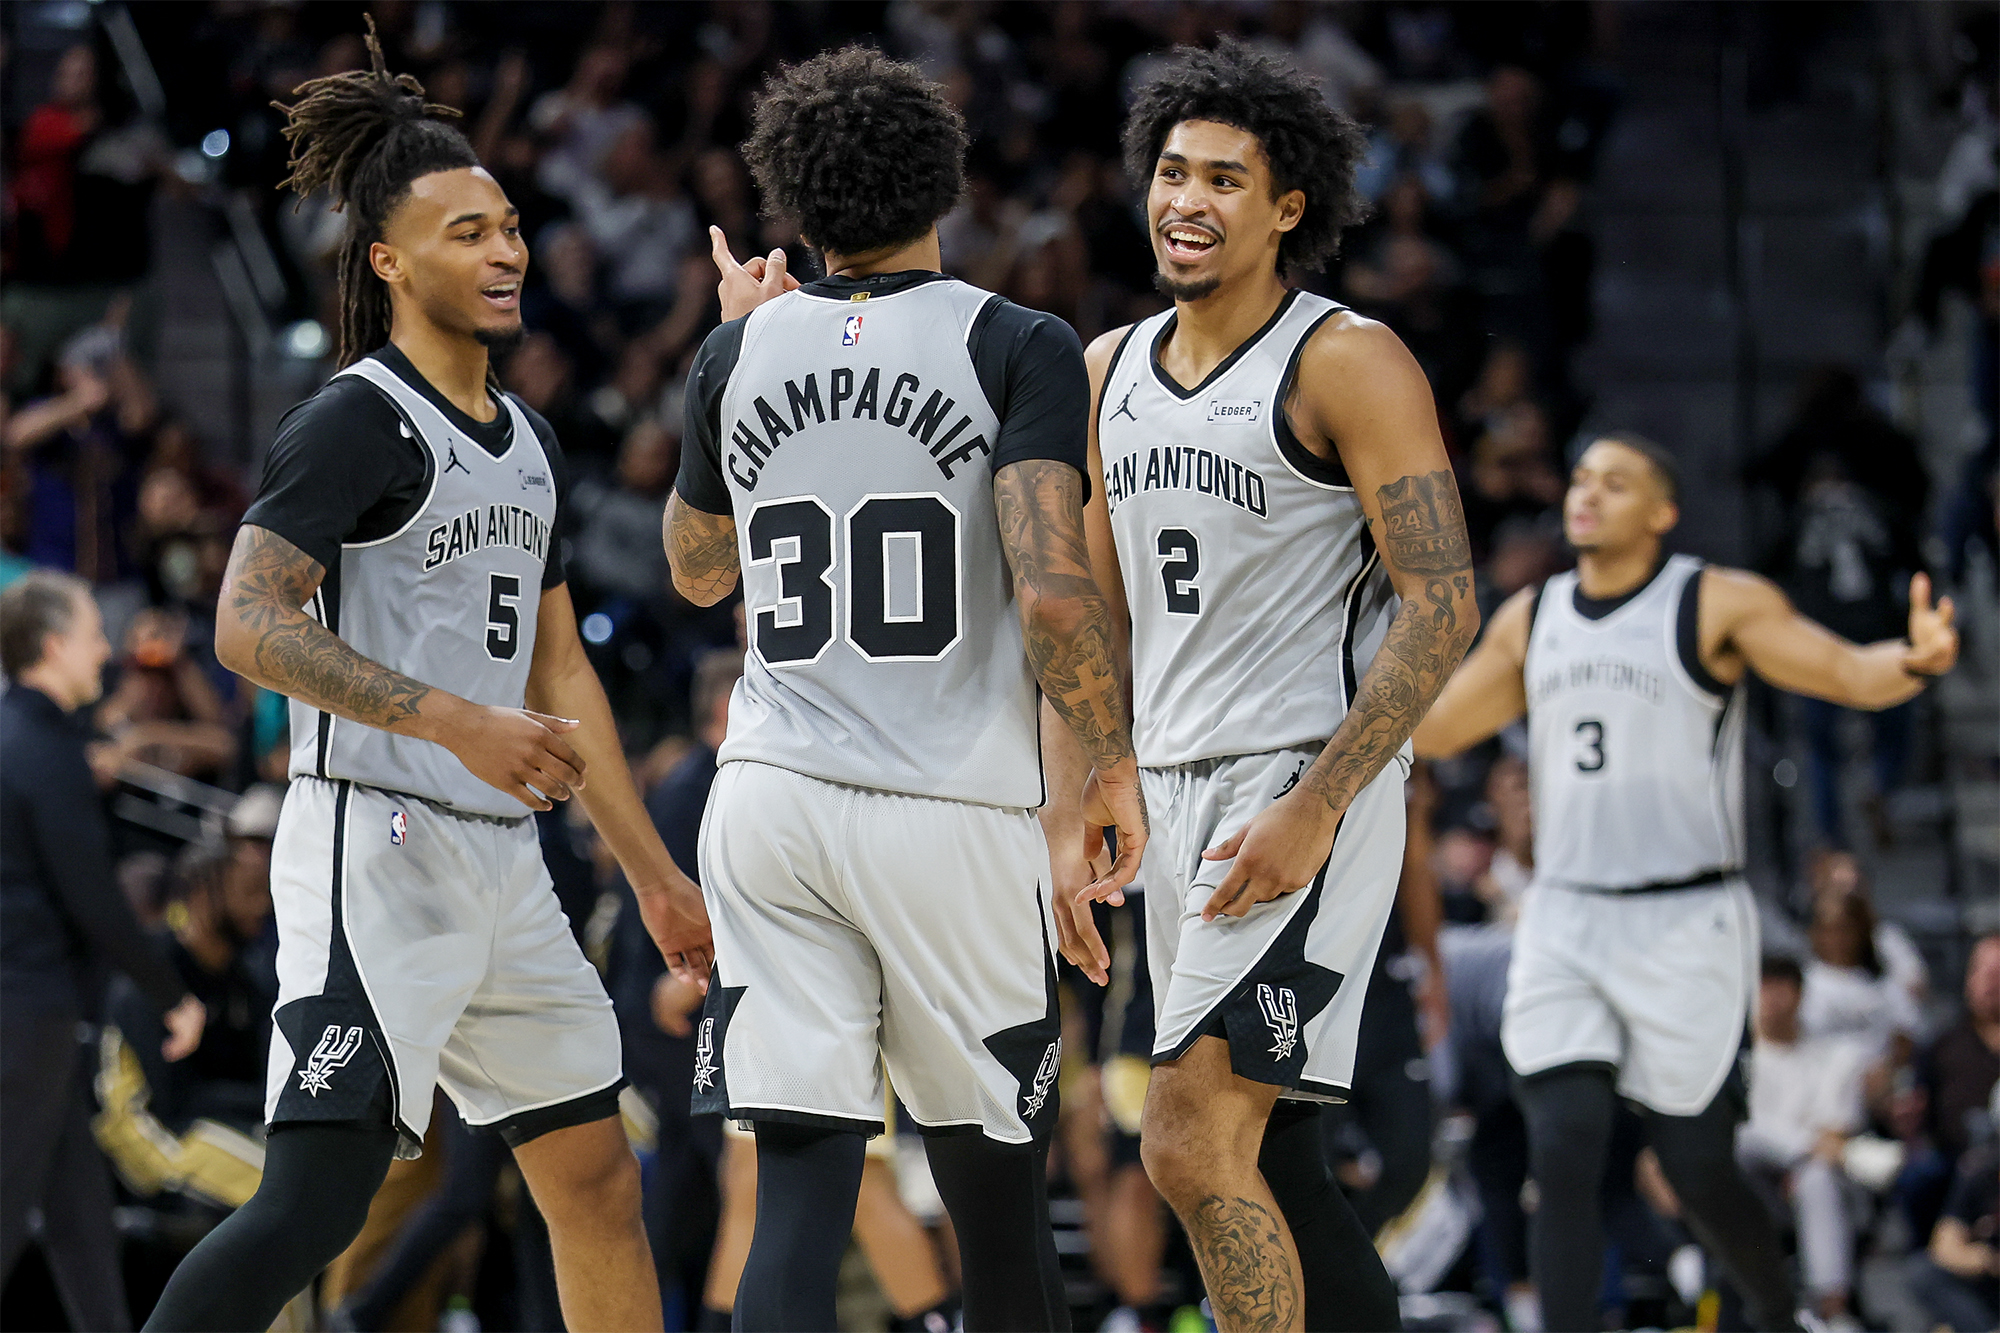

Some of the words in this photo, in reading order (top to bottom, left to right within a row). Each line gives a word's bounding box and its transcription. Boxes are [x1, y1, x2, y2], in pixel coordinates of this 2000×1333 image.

[727, 367, 991, 493] CHAMPAGNIE
[1213, 405, 1253, 417] LEDGER
[1141, 444, 1269, 521] ANTONIO
[423, 506, 482, 573] SAN
[1391, 508, 1422, 535] 24
[744, 490, 964, 670] 30
[1155, 525, 1201, 617] 2
[483, 571, 522, 664] 5
[1573, 718, 1608, 776] 3
